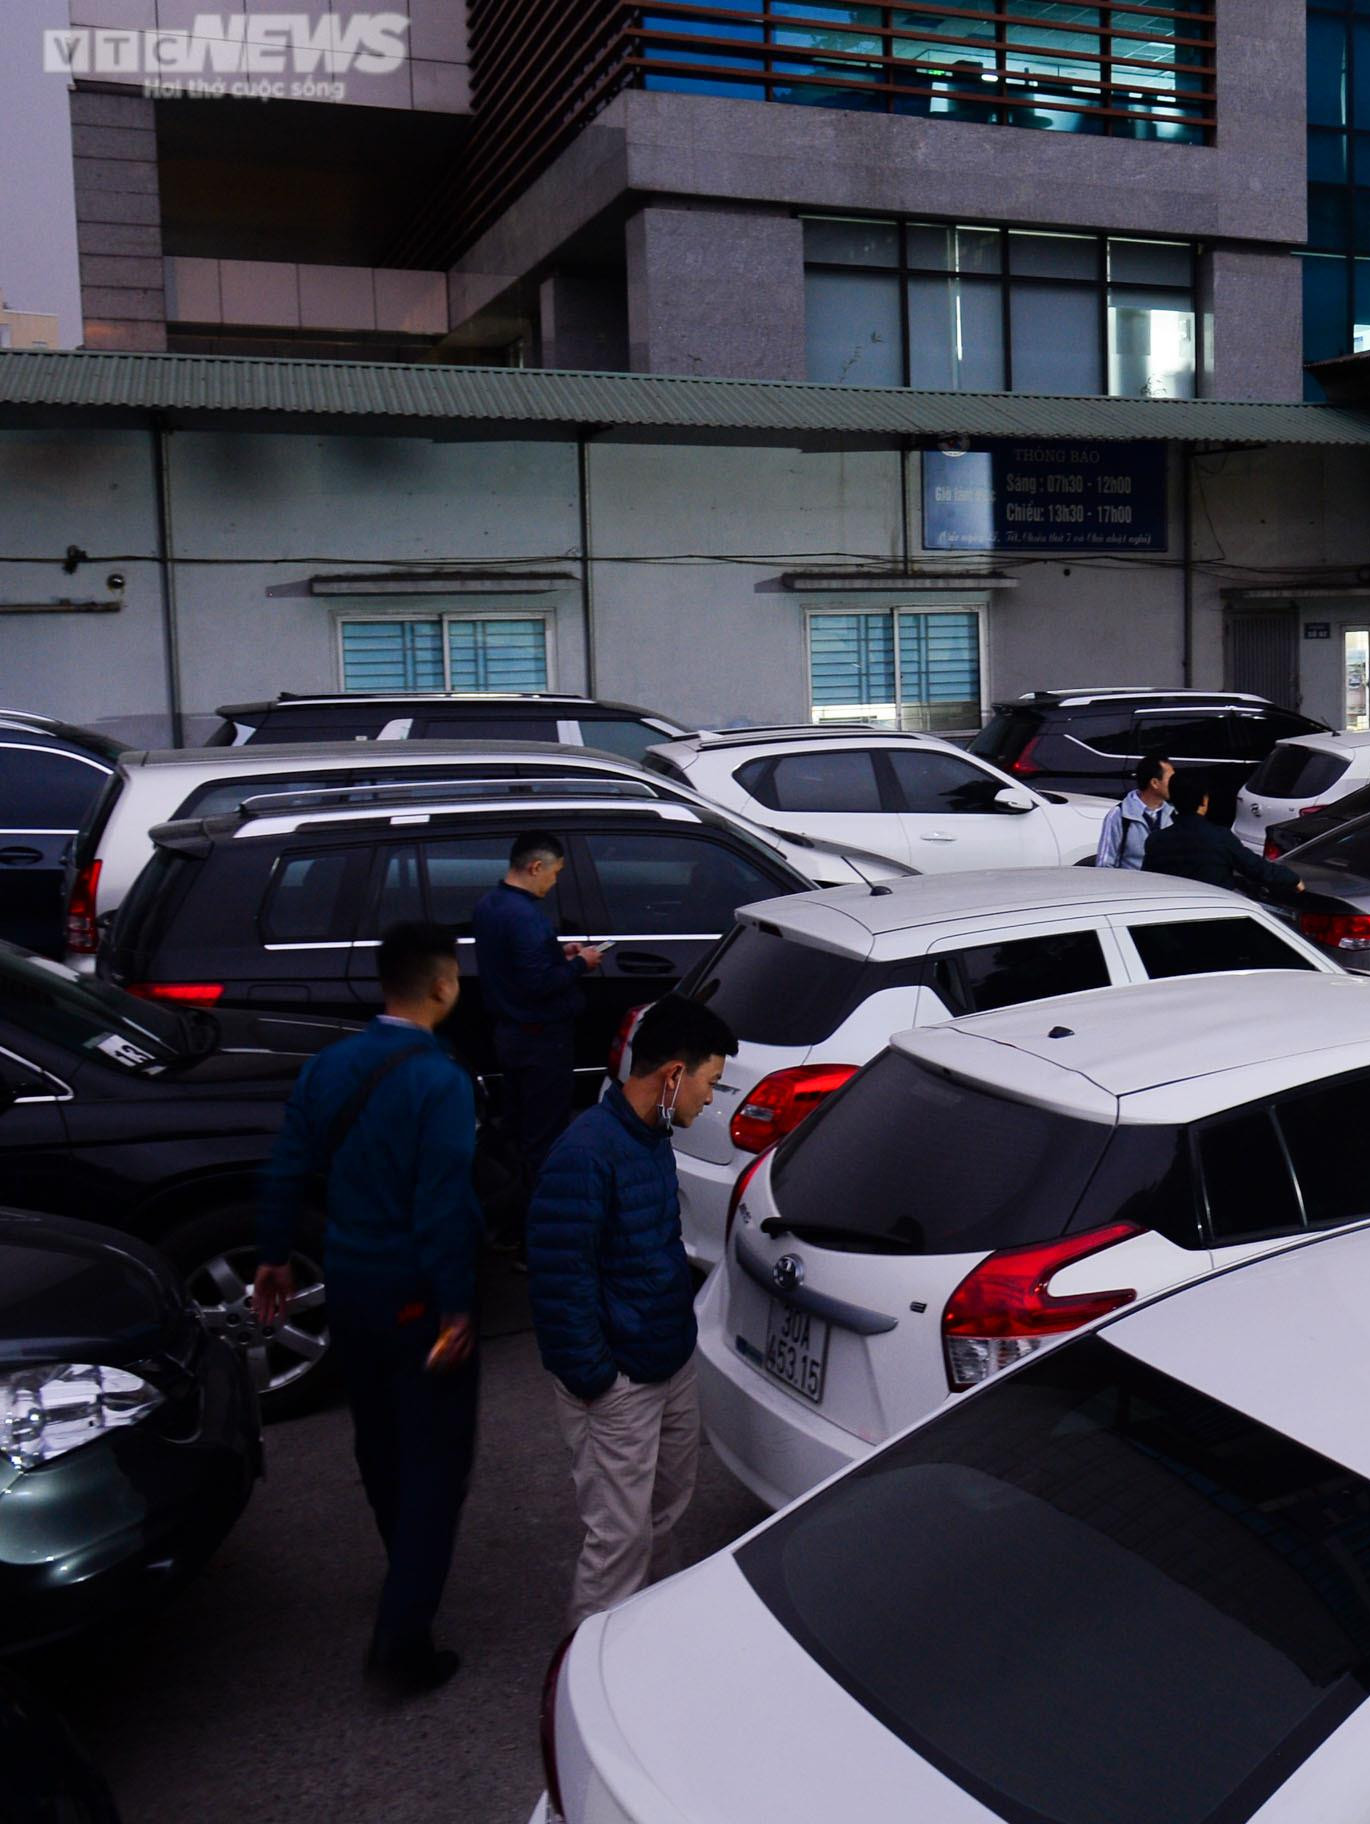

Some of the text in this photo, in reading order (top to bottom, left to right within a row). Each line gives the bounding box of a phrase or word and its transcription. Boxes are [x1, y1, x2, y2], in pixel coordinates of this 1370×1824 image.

[1047, 473, 1083, 493] 07h30
[1097, 476, 1132, 494] 12h00
[1006, 498, 1045, 522] Chiều:
[1048, 503, 1084, 522] 13h30
[1097, 505, 1132, 523] 17h00
[782, 1304, 811, 1351] 30A
[766, 1334, 820, 1396] 453.15
